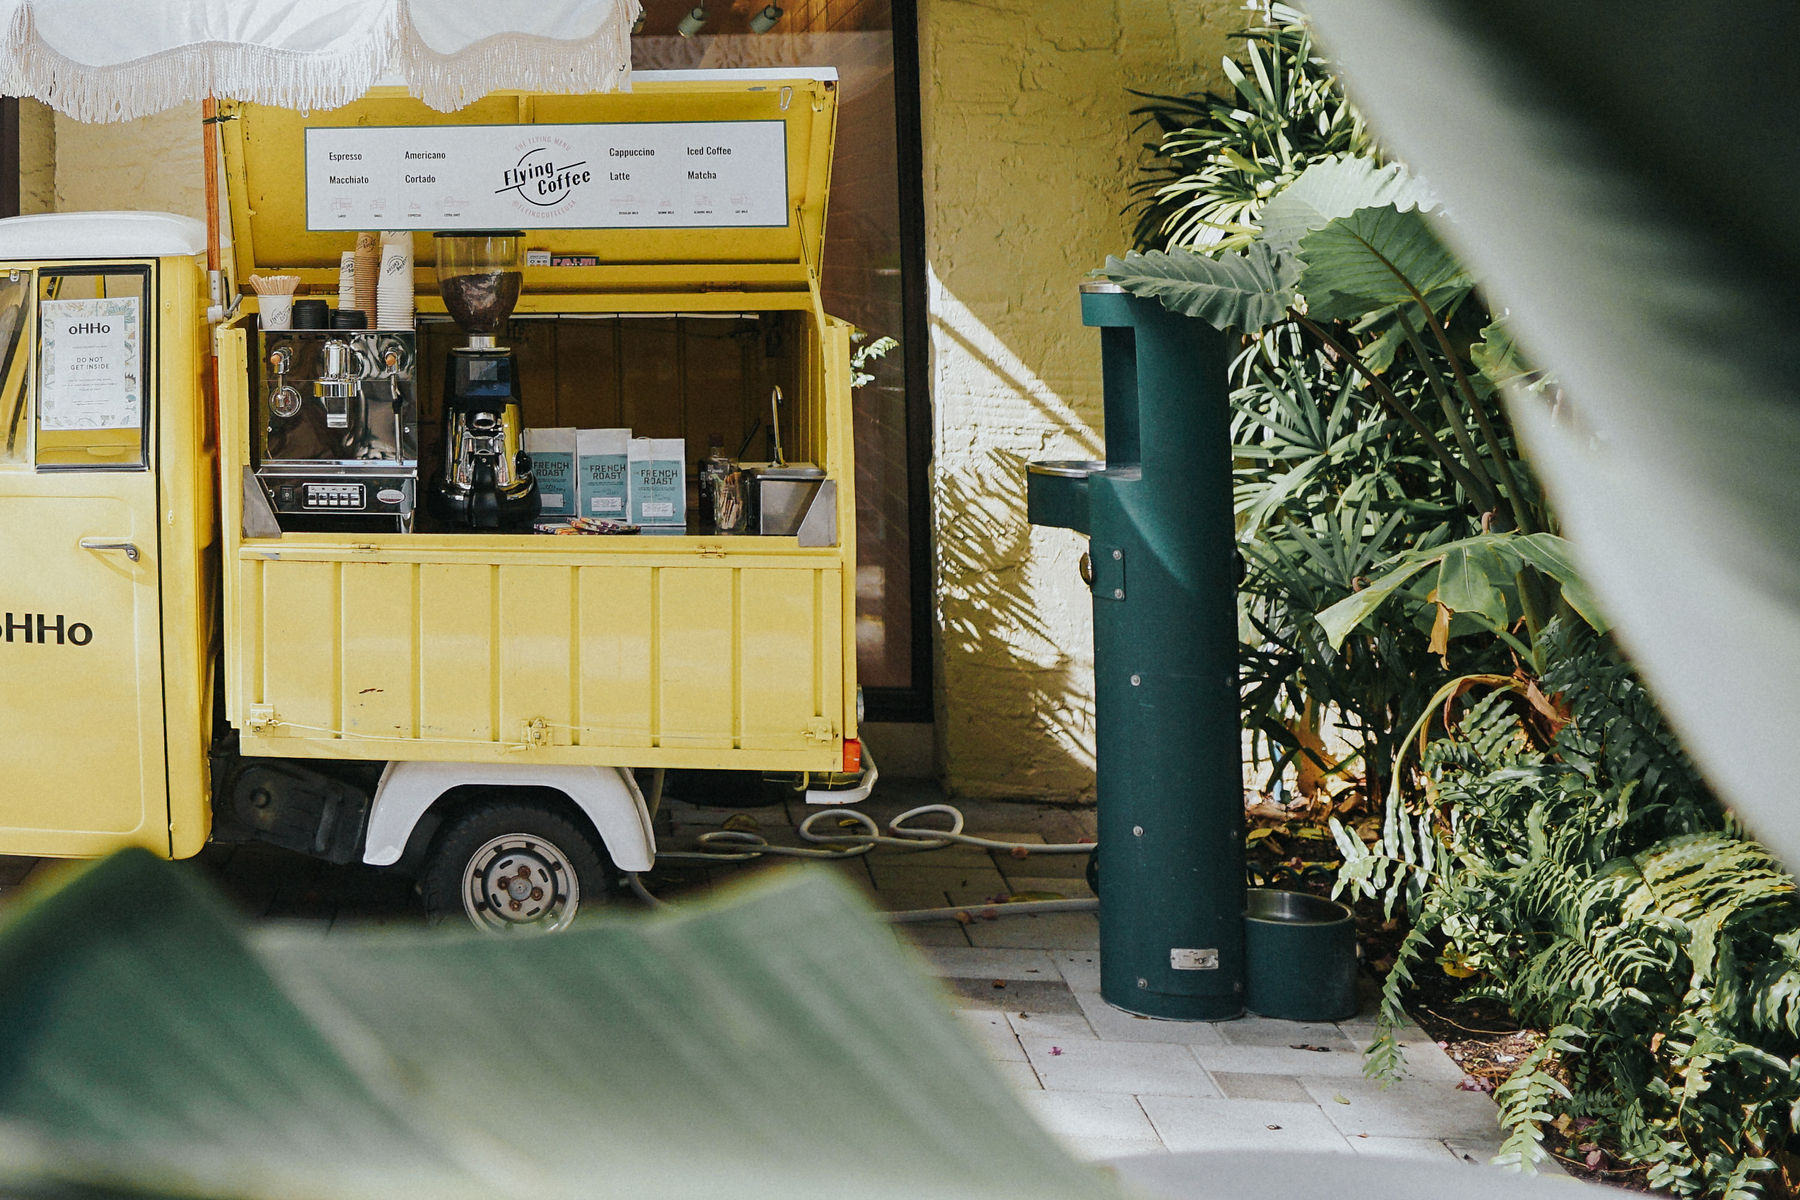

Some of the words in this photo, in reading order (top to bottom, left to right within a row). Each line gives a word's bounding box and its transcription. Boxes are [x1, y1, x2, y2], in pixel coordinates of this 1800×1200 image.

[404, 150, 446, 160] Americano
[609, 147, 655, 158] Cappuccino
[687, 146, 704, 156] Iced
[706, 146, 732, 156] Coffee
[329, 151, 363, 162] Espresso
[405, 174, 436, 184] Cortado
[503, 162, 554, 186] Flying
[609, 171, 631, 181] Latte
[687, 170, 717, 180] Matcha
[329, 175, 369, 185] Macchiato
[537, 170, 591, 195] Coffee
[68, 322, 111, 335] oHHo
[533, 461, 570, 470] FRENCH
[590, 464, 626, 473] FRENCH
[536, 469, 565, 477] ROAST
[592, 472, 622, 480] ROAST
[640, 469, 678, 478] FRENCH
[643, 477, 673, 485] ROAST
